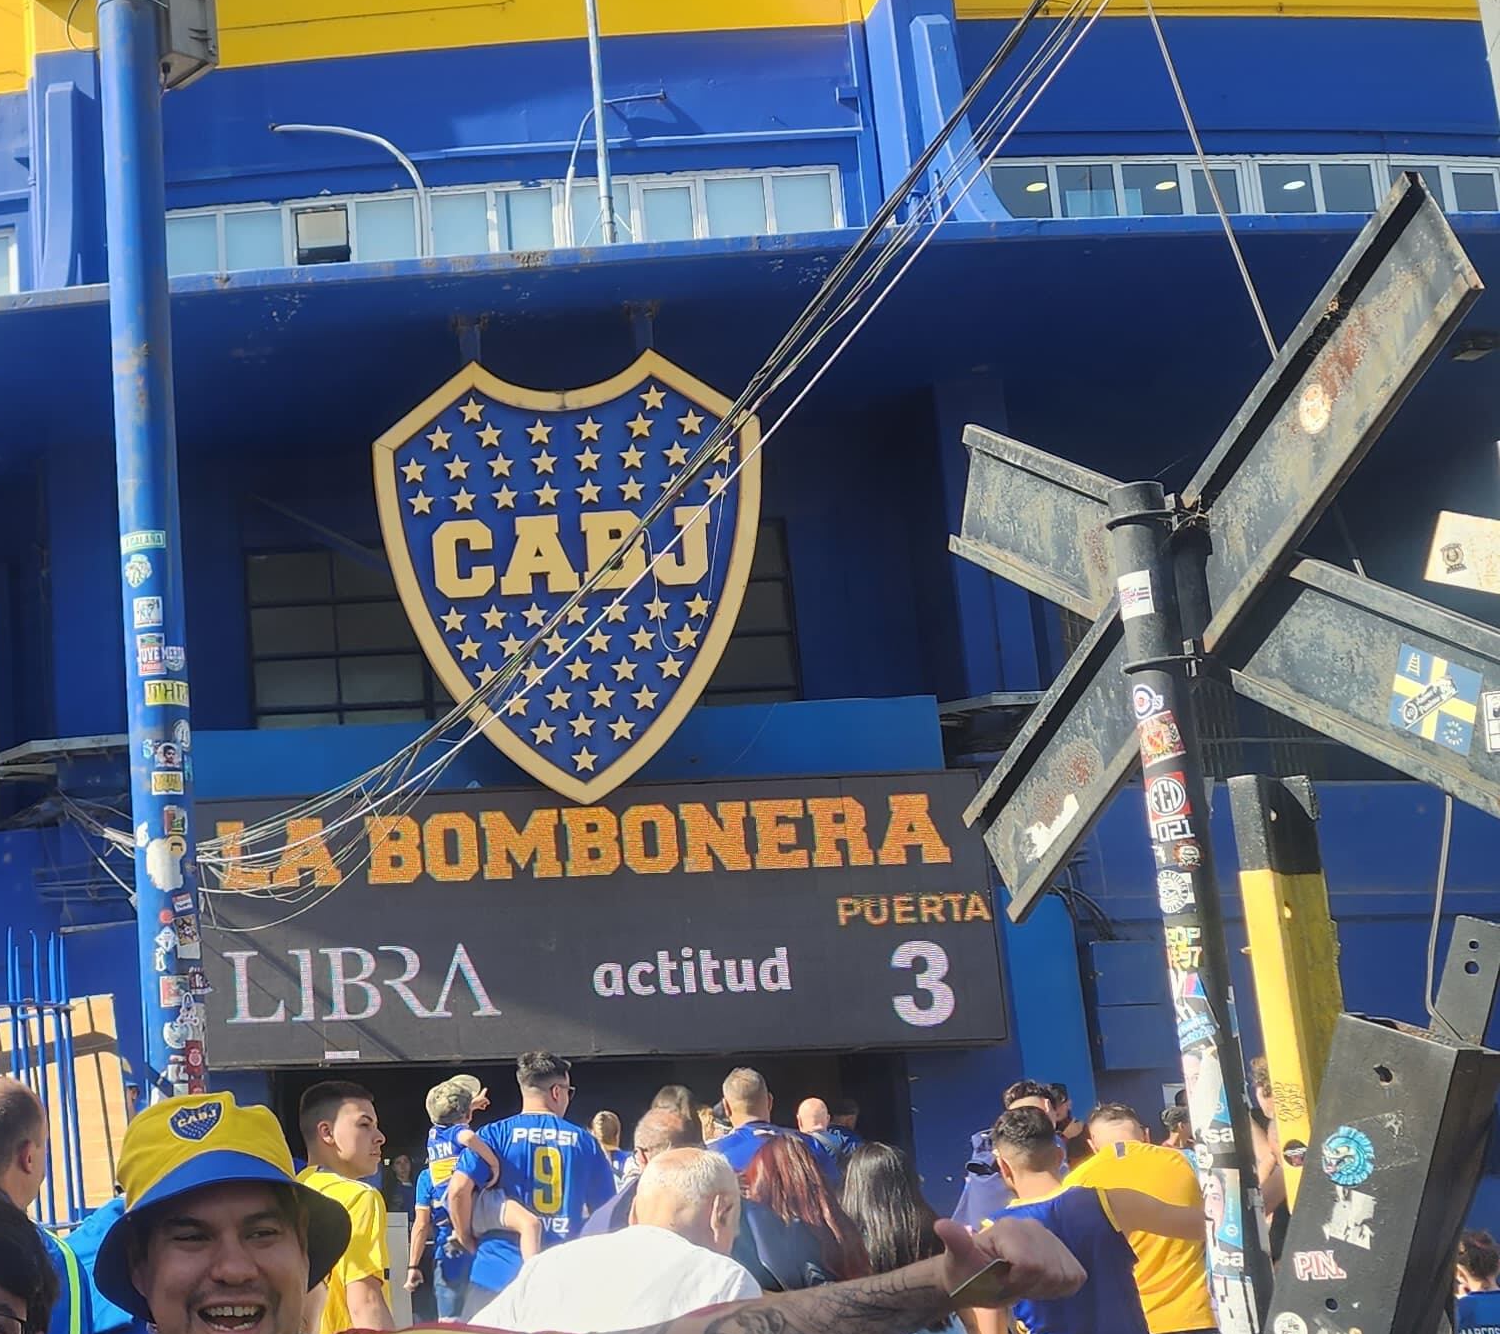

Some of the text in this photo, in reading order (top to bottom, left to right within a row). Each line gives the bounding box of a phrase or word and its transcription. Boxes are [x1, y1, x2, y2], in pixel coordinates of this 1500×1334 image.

[432, 506, 710, 598] CABJ
[216, 793, 951, 889] LA BOMBONERA
[836, 892, 992, 925] PUERTA
[223, 943, 792, 1023] LIBRA actitud
[891, 941, 955, 1027] 3
[512, 1128, 579, 1146] PEPSI
[533, 1146, 563, 1215] 9
[541, 1217, 569, 1234] VEZ
